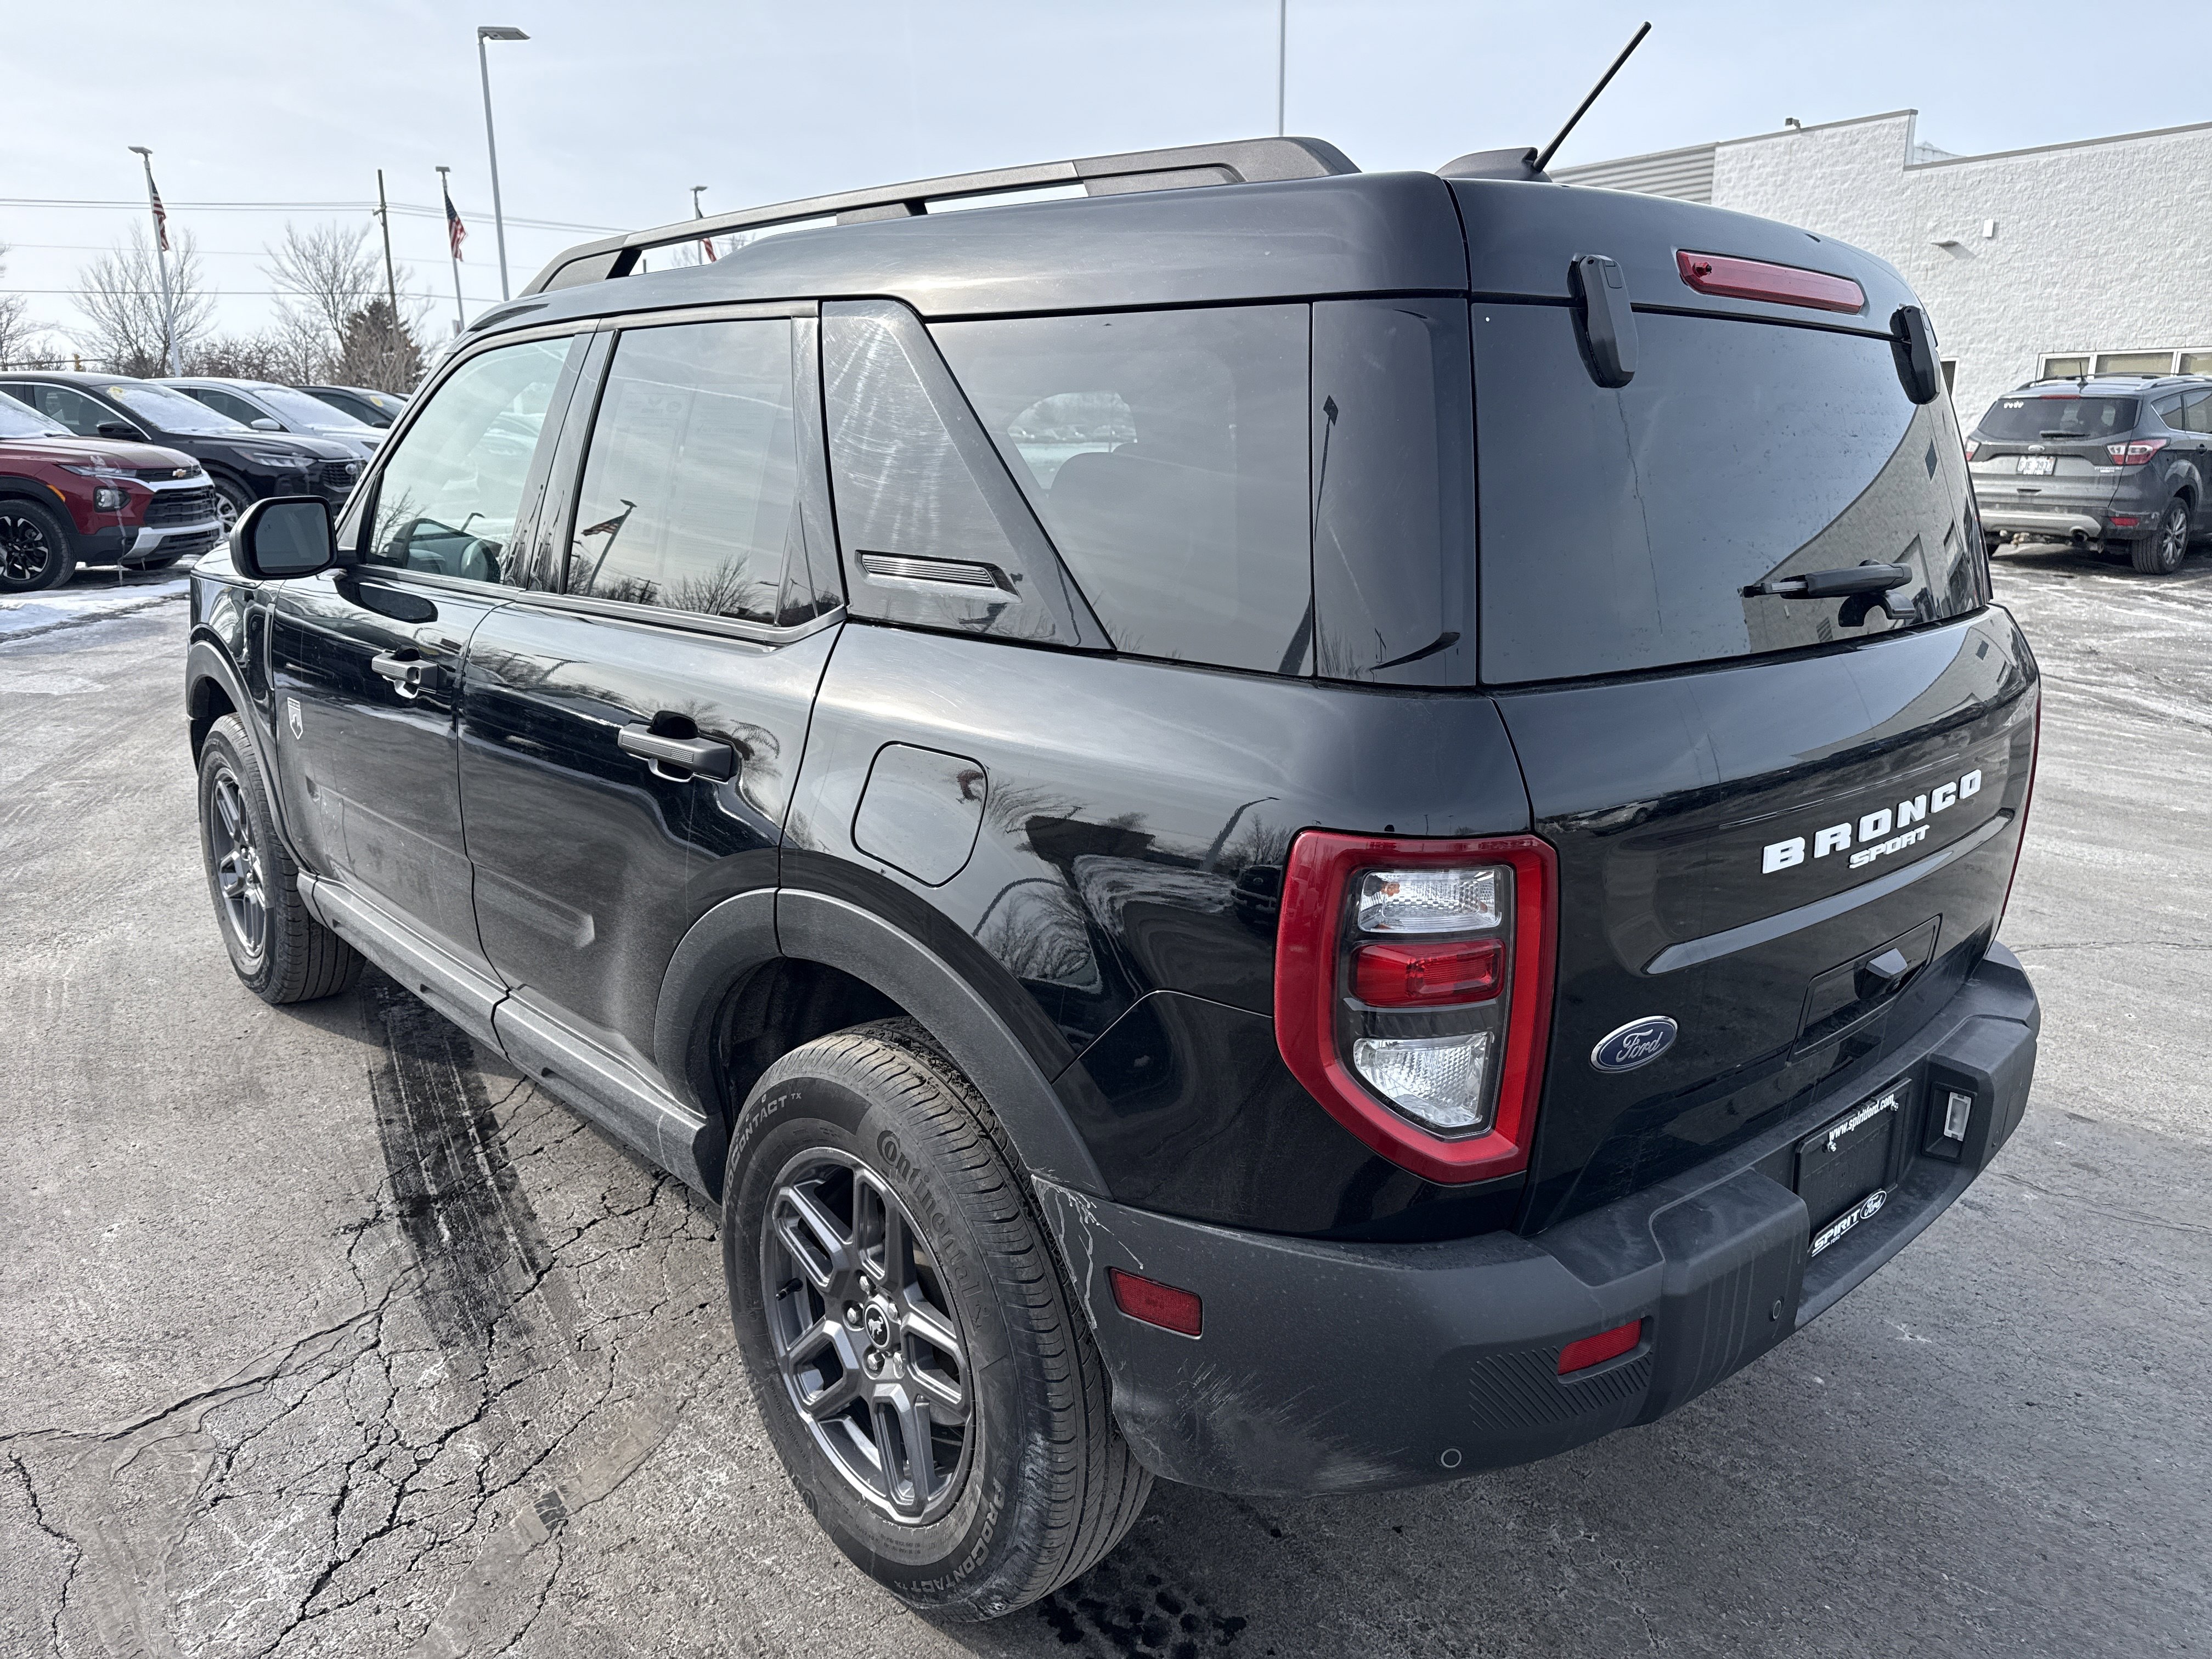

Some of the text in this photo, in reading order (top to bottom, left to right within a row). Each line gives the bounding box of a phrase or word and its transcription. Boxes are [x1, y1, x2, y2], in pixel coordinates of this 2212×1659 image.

[1762, 769, 1982, 874] BRONCO
[1848, 824, 1930, 870] SPORT
[1615, 1029, 1664, 1063] Ford
[790, 1092, 802, 1101] TX
[1829, 1093, 1894, 1142] www.spiritford.com
[877, 1130, 984, 1299] Continental
[1812, 1208, 1861, 1255] SPIRIT
